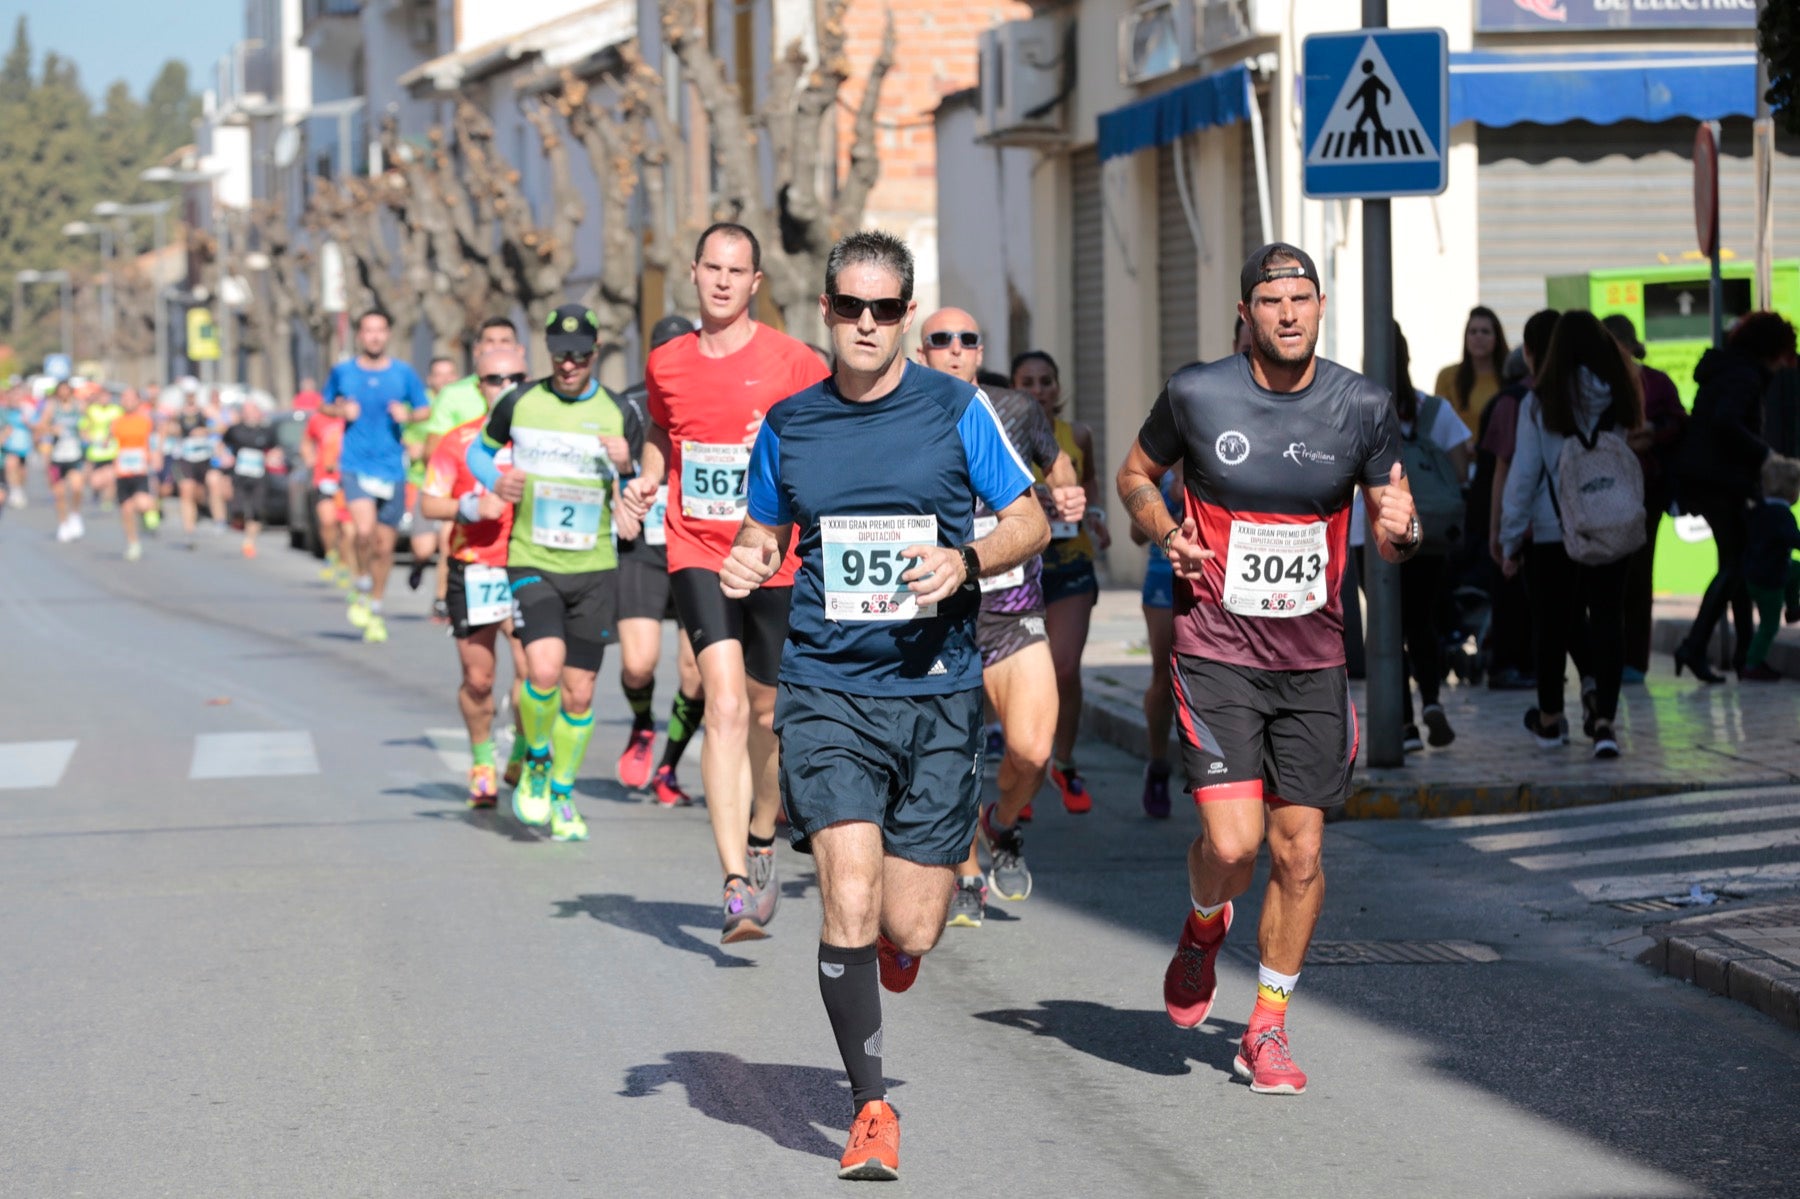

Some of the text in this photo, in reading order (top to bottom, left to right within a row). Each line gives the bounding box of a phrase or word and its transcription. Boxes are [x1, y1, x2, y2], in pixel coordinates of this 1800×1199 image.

[695, 468, 747, 495] 567
[560, 506, 575, 527] 2
[849, 520, 868, 530] GRAN
[869, 519, 895, 529] PREMIO
[897, 519, 906, 529] DE
[907, 518, 931, 529] FONDO
[842, 549, 918, 586] 952
[1241, 553, 1321, 583] 3043
